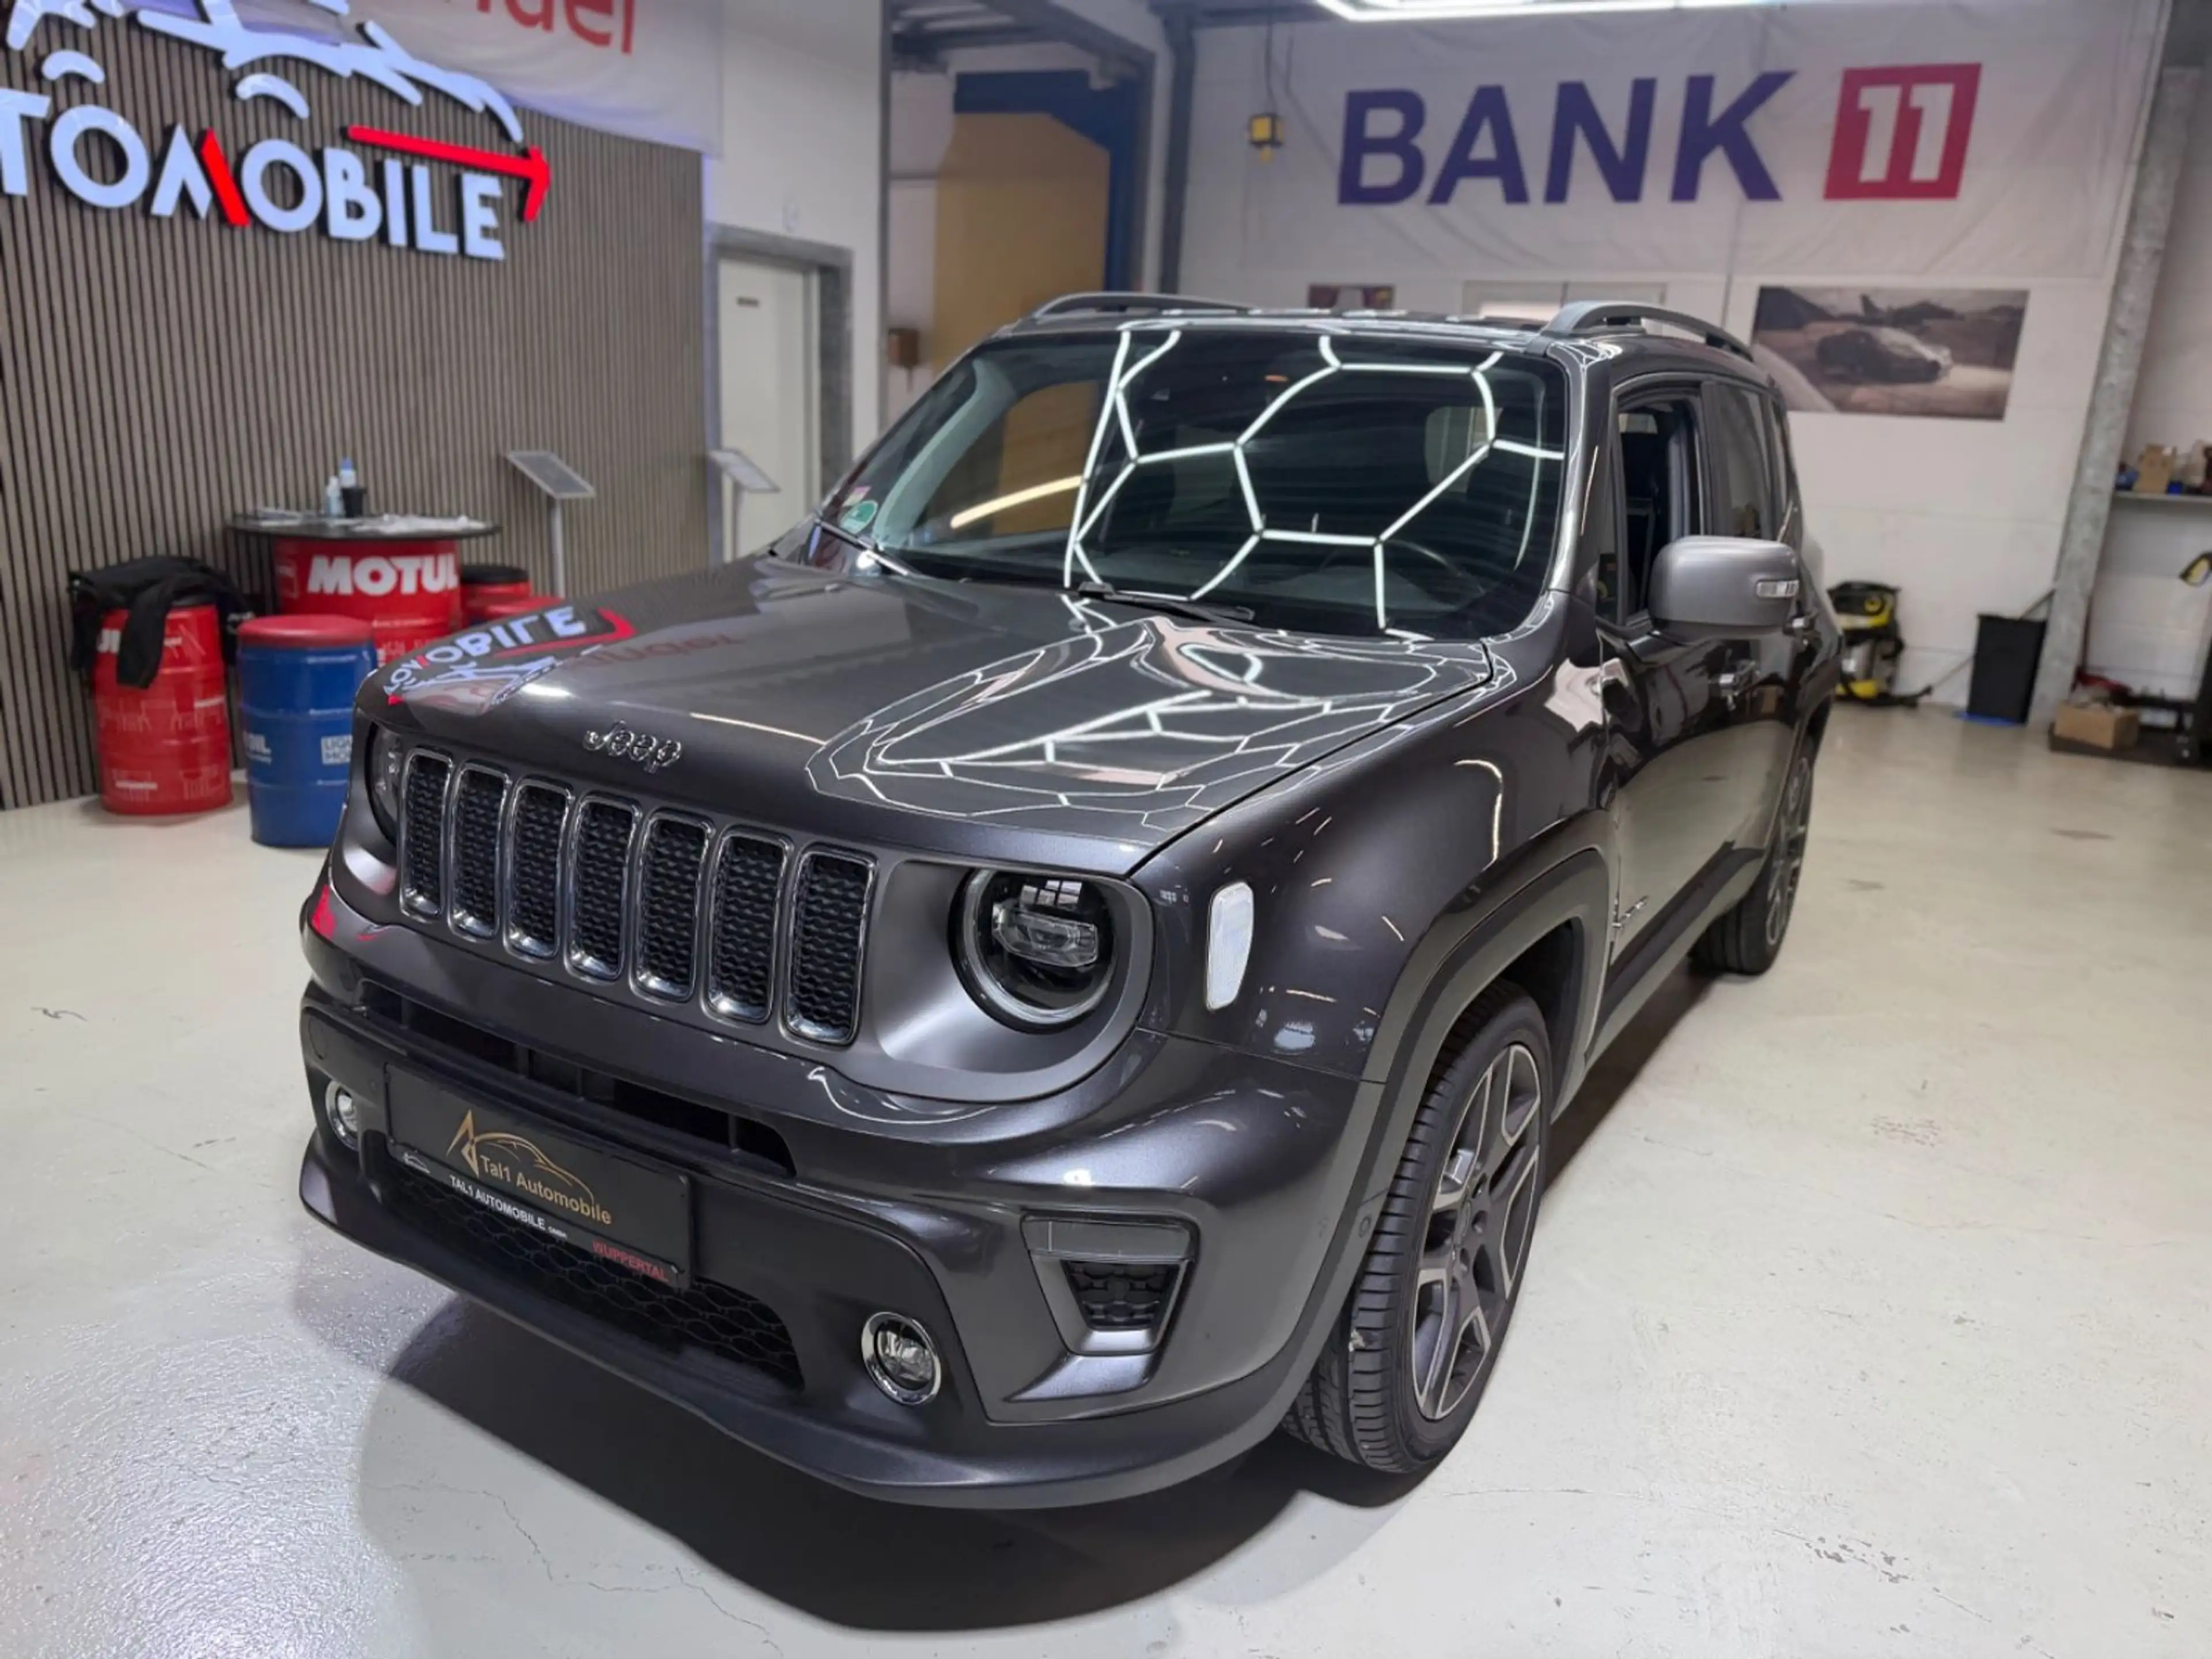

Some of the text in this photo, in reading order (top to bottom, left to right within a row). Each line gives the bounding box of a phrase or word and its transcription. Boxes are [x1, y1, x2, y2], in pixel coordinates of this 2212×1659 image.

[1337, 70, 1955, 206] BANK 11
[582, 719, 684, 775] Jeep
[475, 1188, 547, 1231] AUTOMOBILE
[592, 1238, 670, 1283] WUPPERTAL
[516, 1171, 613, 1225] Automobile
